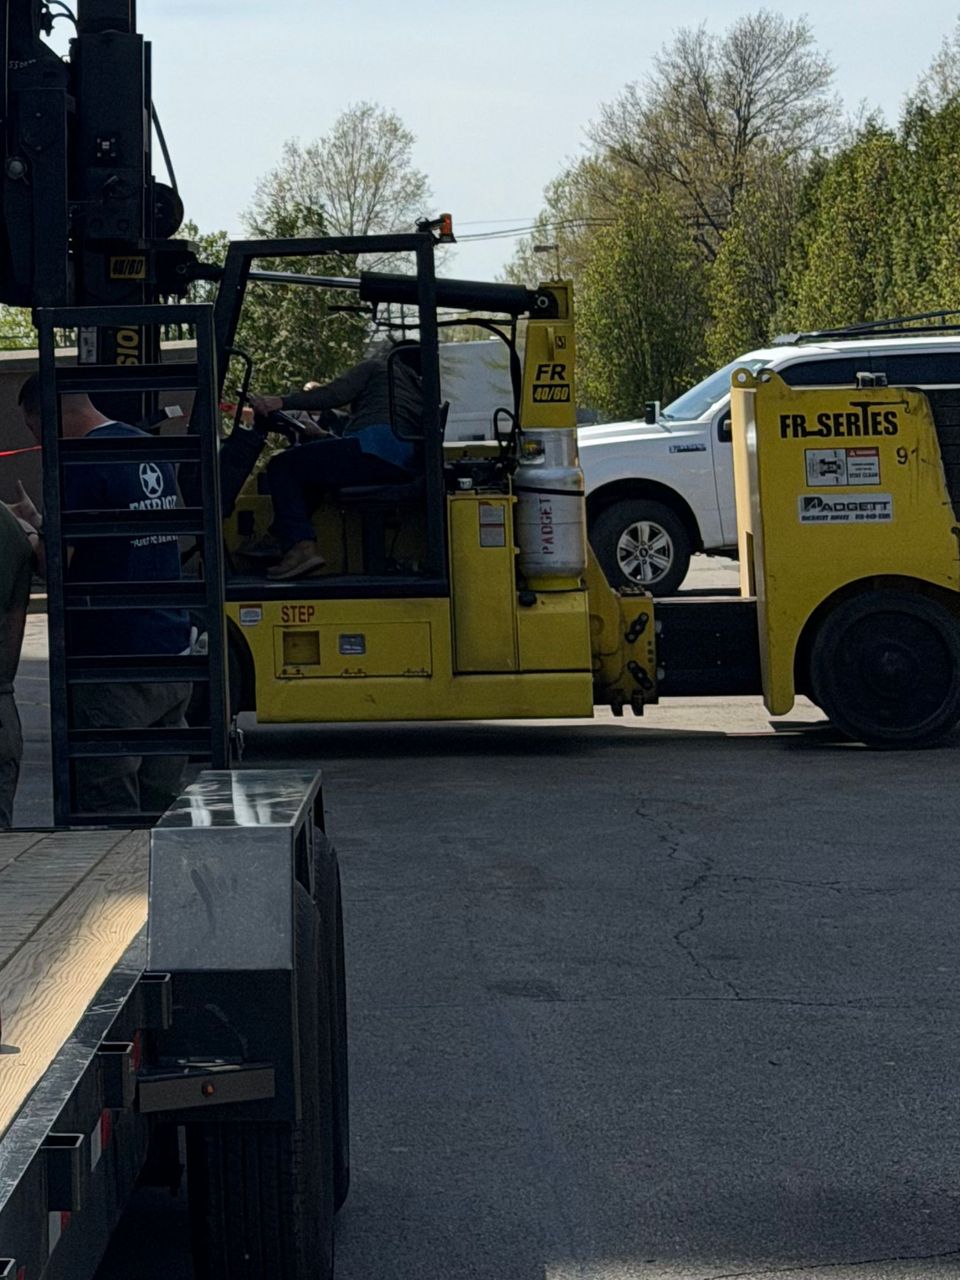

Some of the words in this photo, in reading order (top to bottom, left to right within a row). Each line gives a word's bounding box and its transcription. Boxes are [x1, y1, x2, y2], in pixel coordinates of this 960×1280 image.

[536, 364, 566, 381] FR
[534, 386, 569, 401] 40/60
[281, 605, 315, 623] STEP
